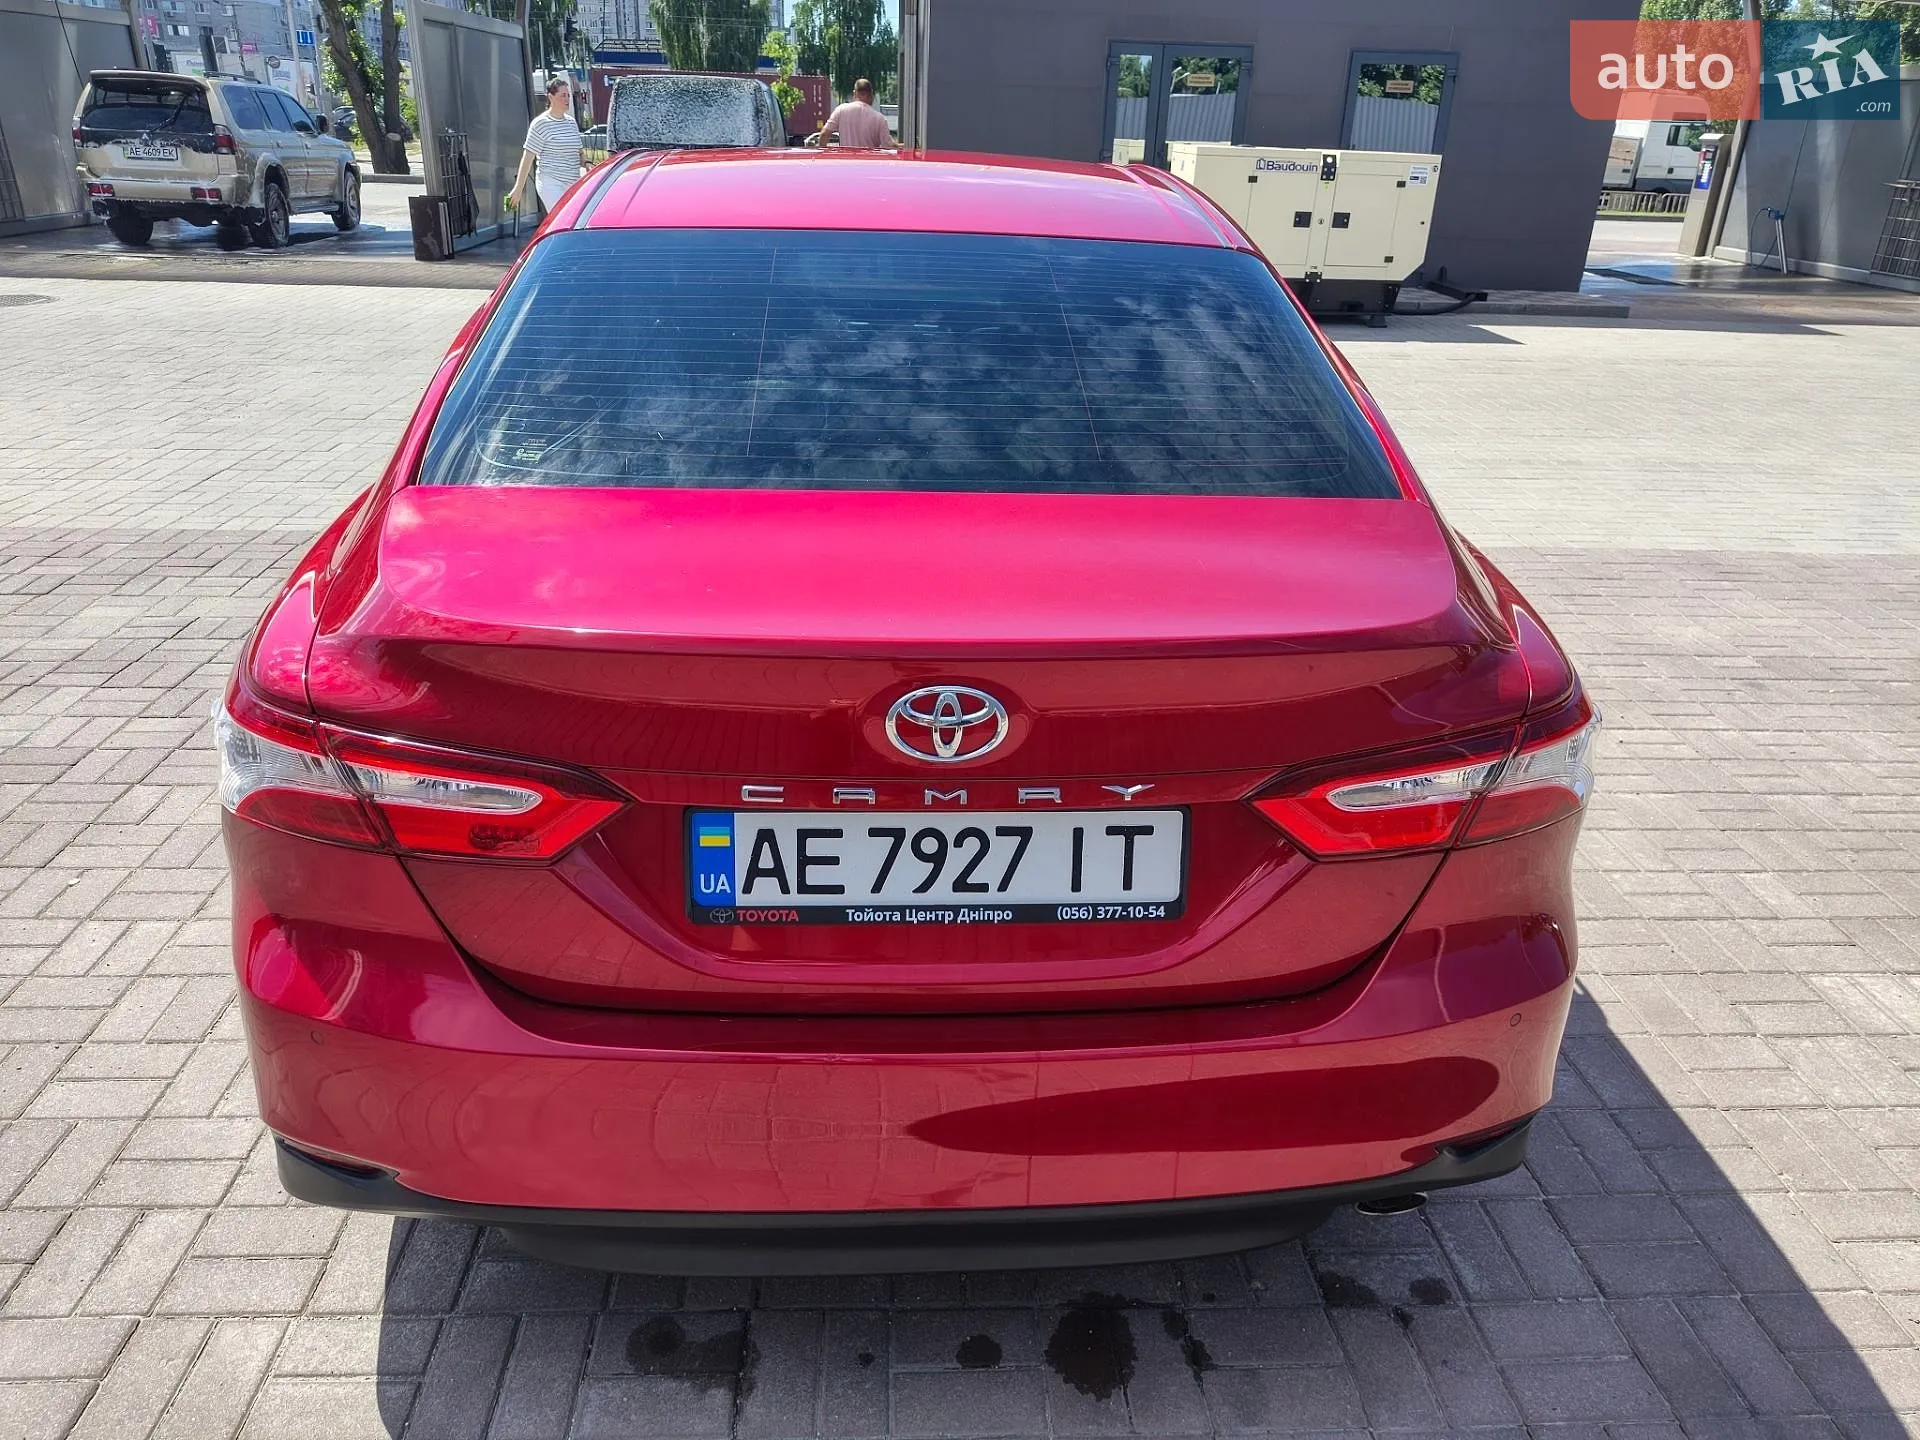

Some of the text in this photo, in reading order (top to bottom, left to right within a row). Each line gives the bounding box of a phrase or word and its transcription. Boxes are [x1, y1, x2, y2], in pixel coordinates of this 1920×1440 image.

[130, 147, 175, 158] AE 4609 EK
[1266, 160, 1318, 173] Baudouin
[741, 783, 1155, 805] CAMRY
[741, 825, 1155, 895] AE 7927 IT
[700, 873, 731, 894] UA
[737, 909, 799, 922] TOYOTA
[846, 908, 1013, 924] Тойота Центр Дніпро
[1056, 905, 1166, 921] (056) 377-10-54
